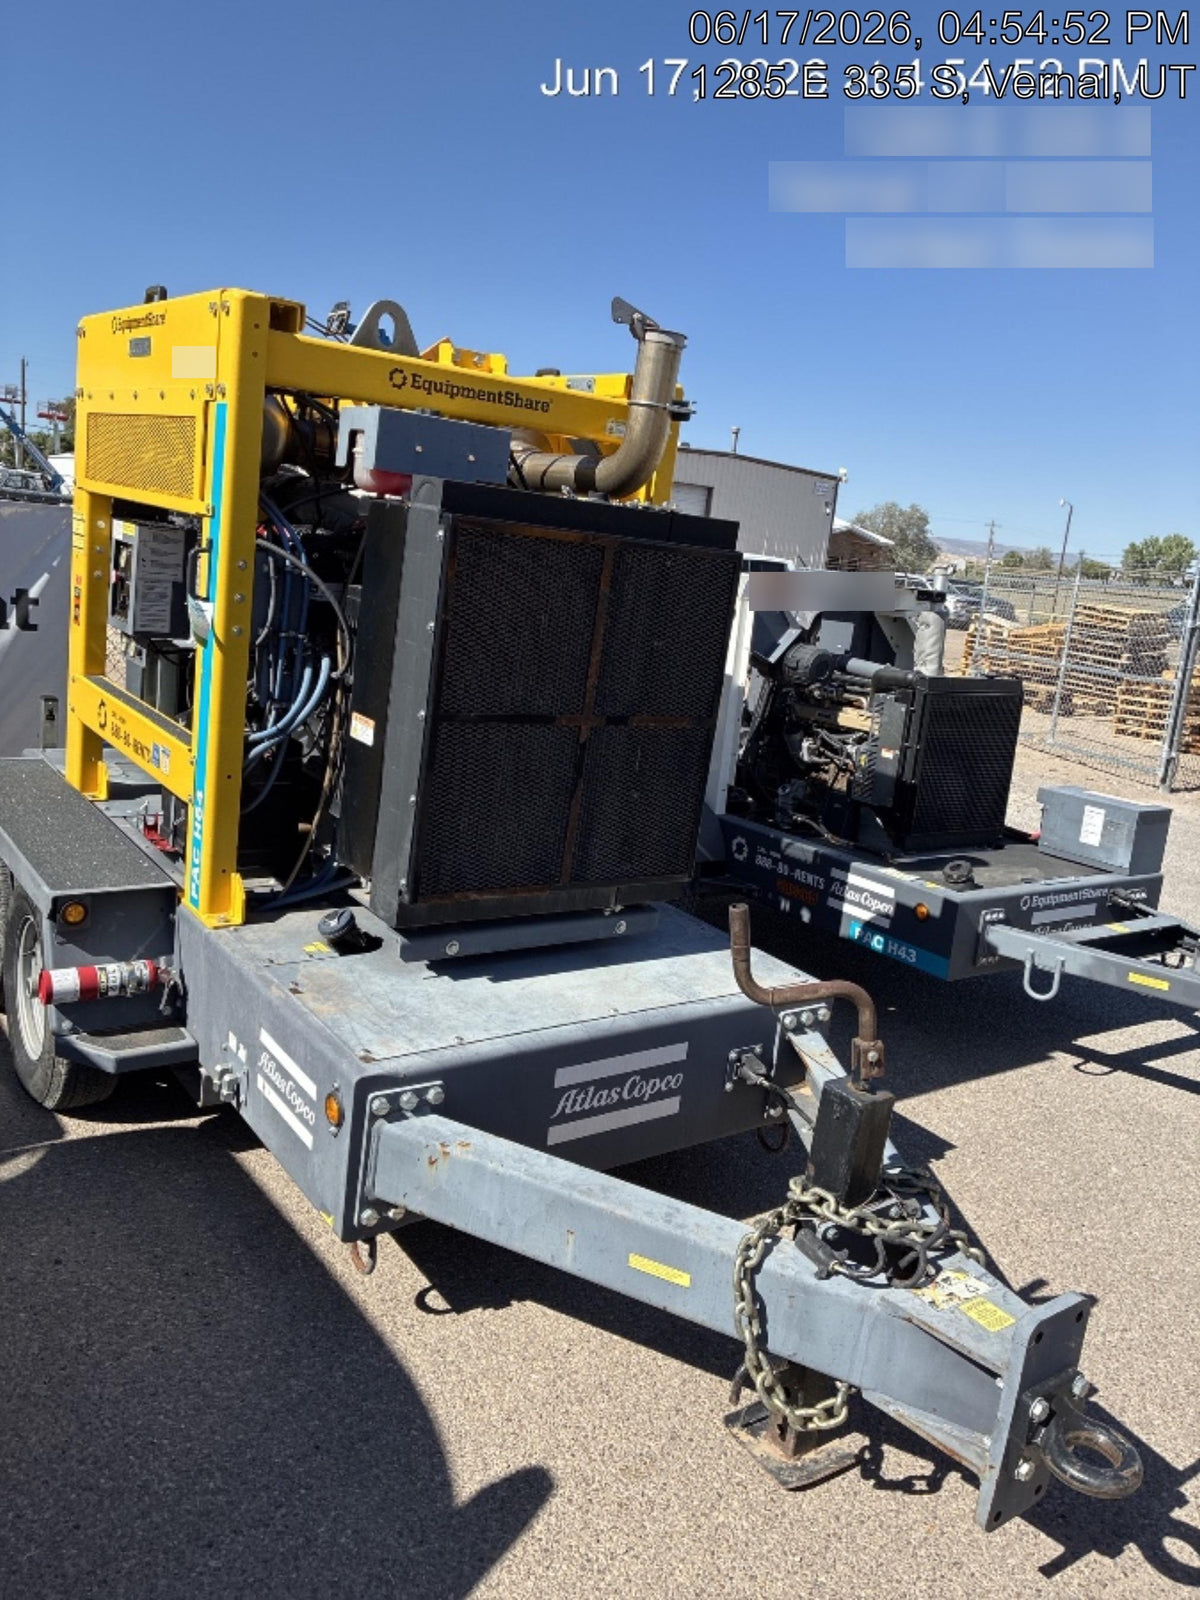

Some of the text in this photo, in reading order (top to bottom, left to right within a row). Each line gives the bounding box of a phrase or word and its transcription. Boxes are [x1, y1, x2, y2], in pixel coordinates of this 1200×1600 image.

[410, 372, 550, 413] EquipmentShare
[1030, 887, 1109, 908] EquipmentShare
[853, 926, 917, 962] PAC H43
